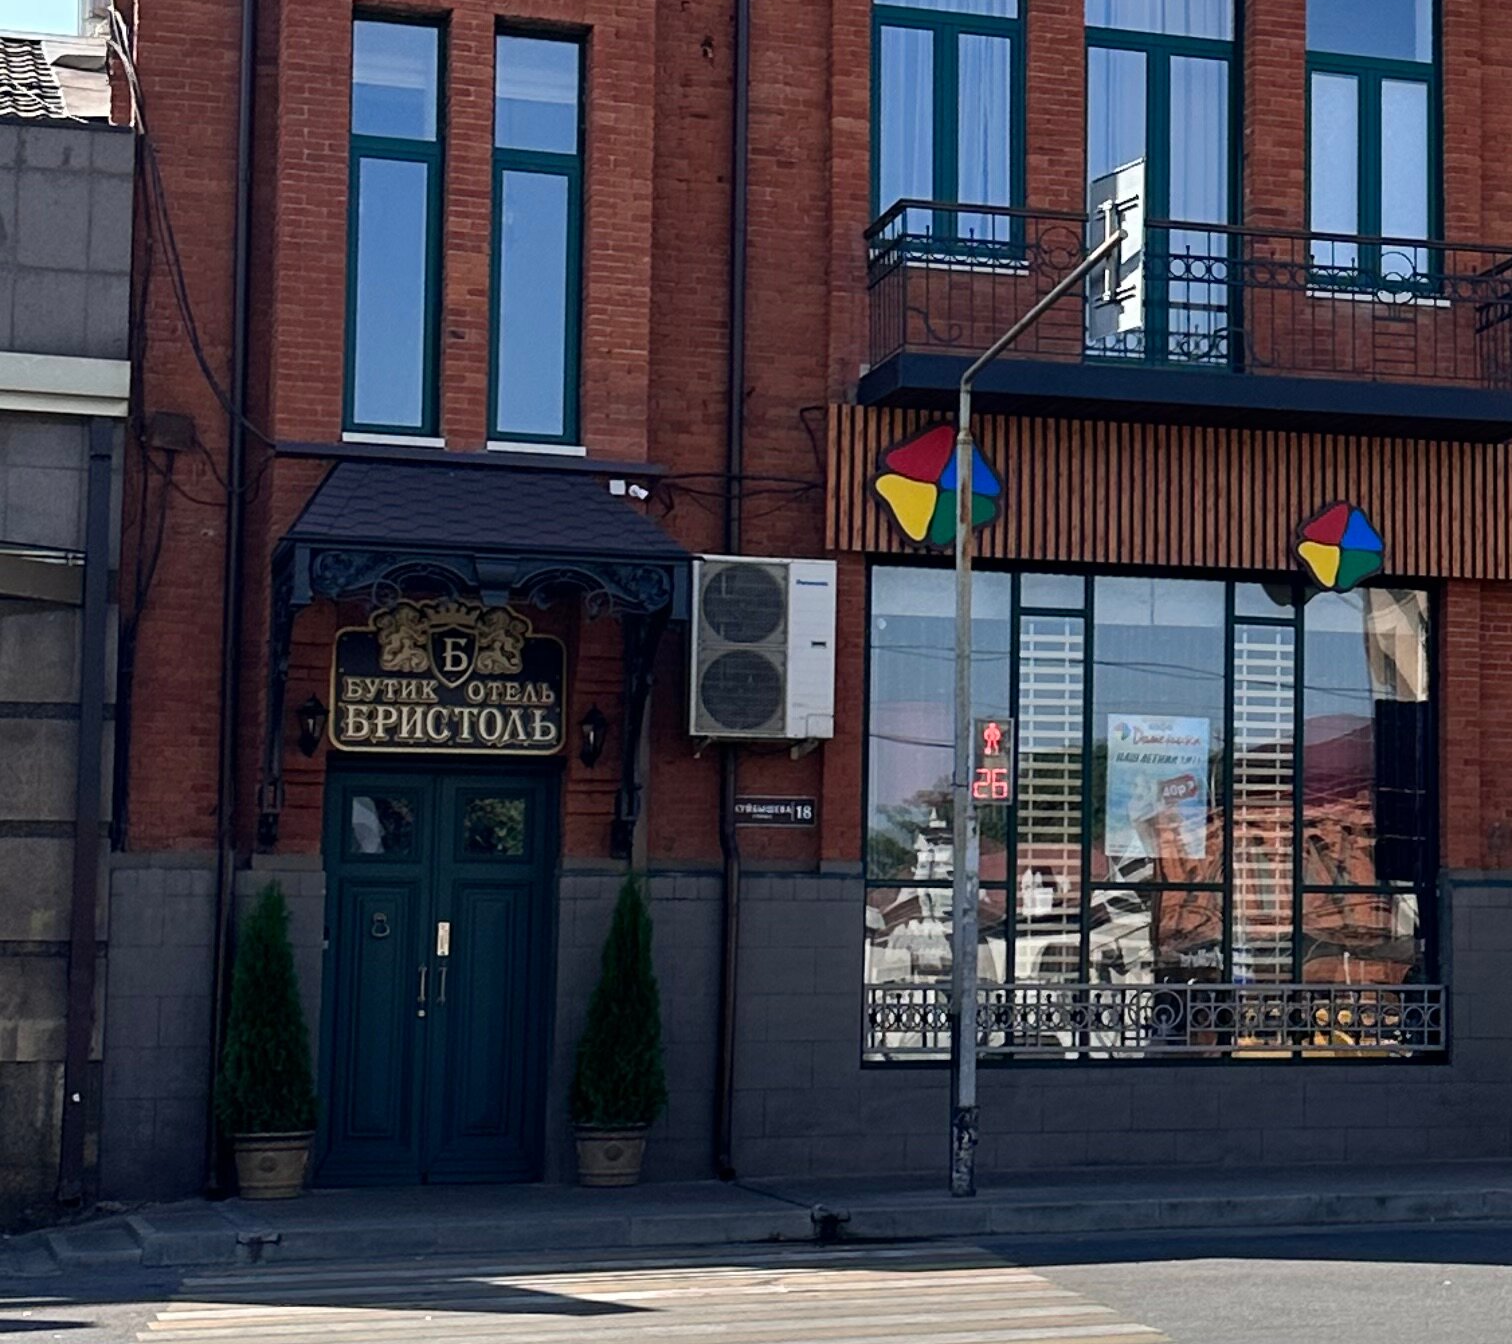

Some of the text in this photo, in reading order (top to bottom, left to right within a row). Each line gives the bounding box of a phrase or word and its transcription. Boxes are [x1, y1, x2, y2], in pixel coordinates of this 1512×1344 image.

[442, 637, 469, 673] Б
[343, 677, 556, 704] БУТИК ОТЕЛЬ
[340, 704, 557, 744] БРИСТОЛЬ
[973, 768, 1008, 799] 26
[796, 805, 812, 819] 18
